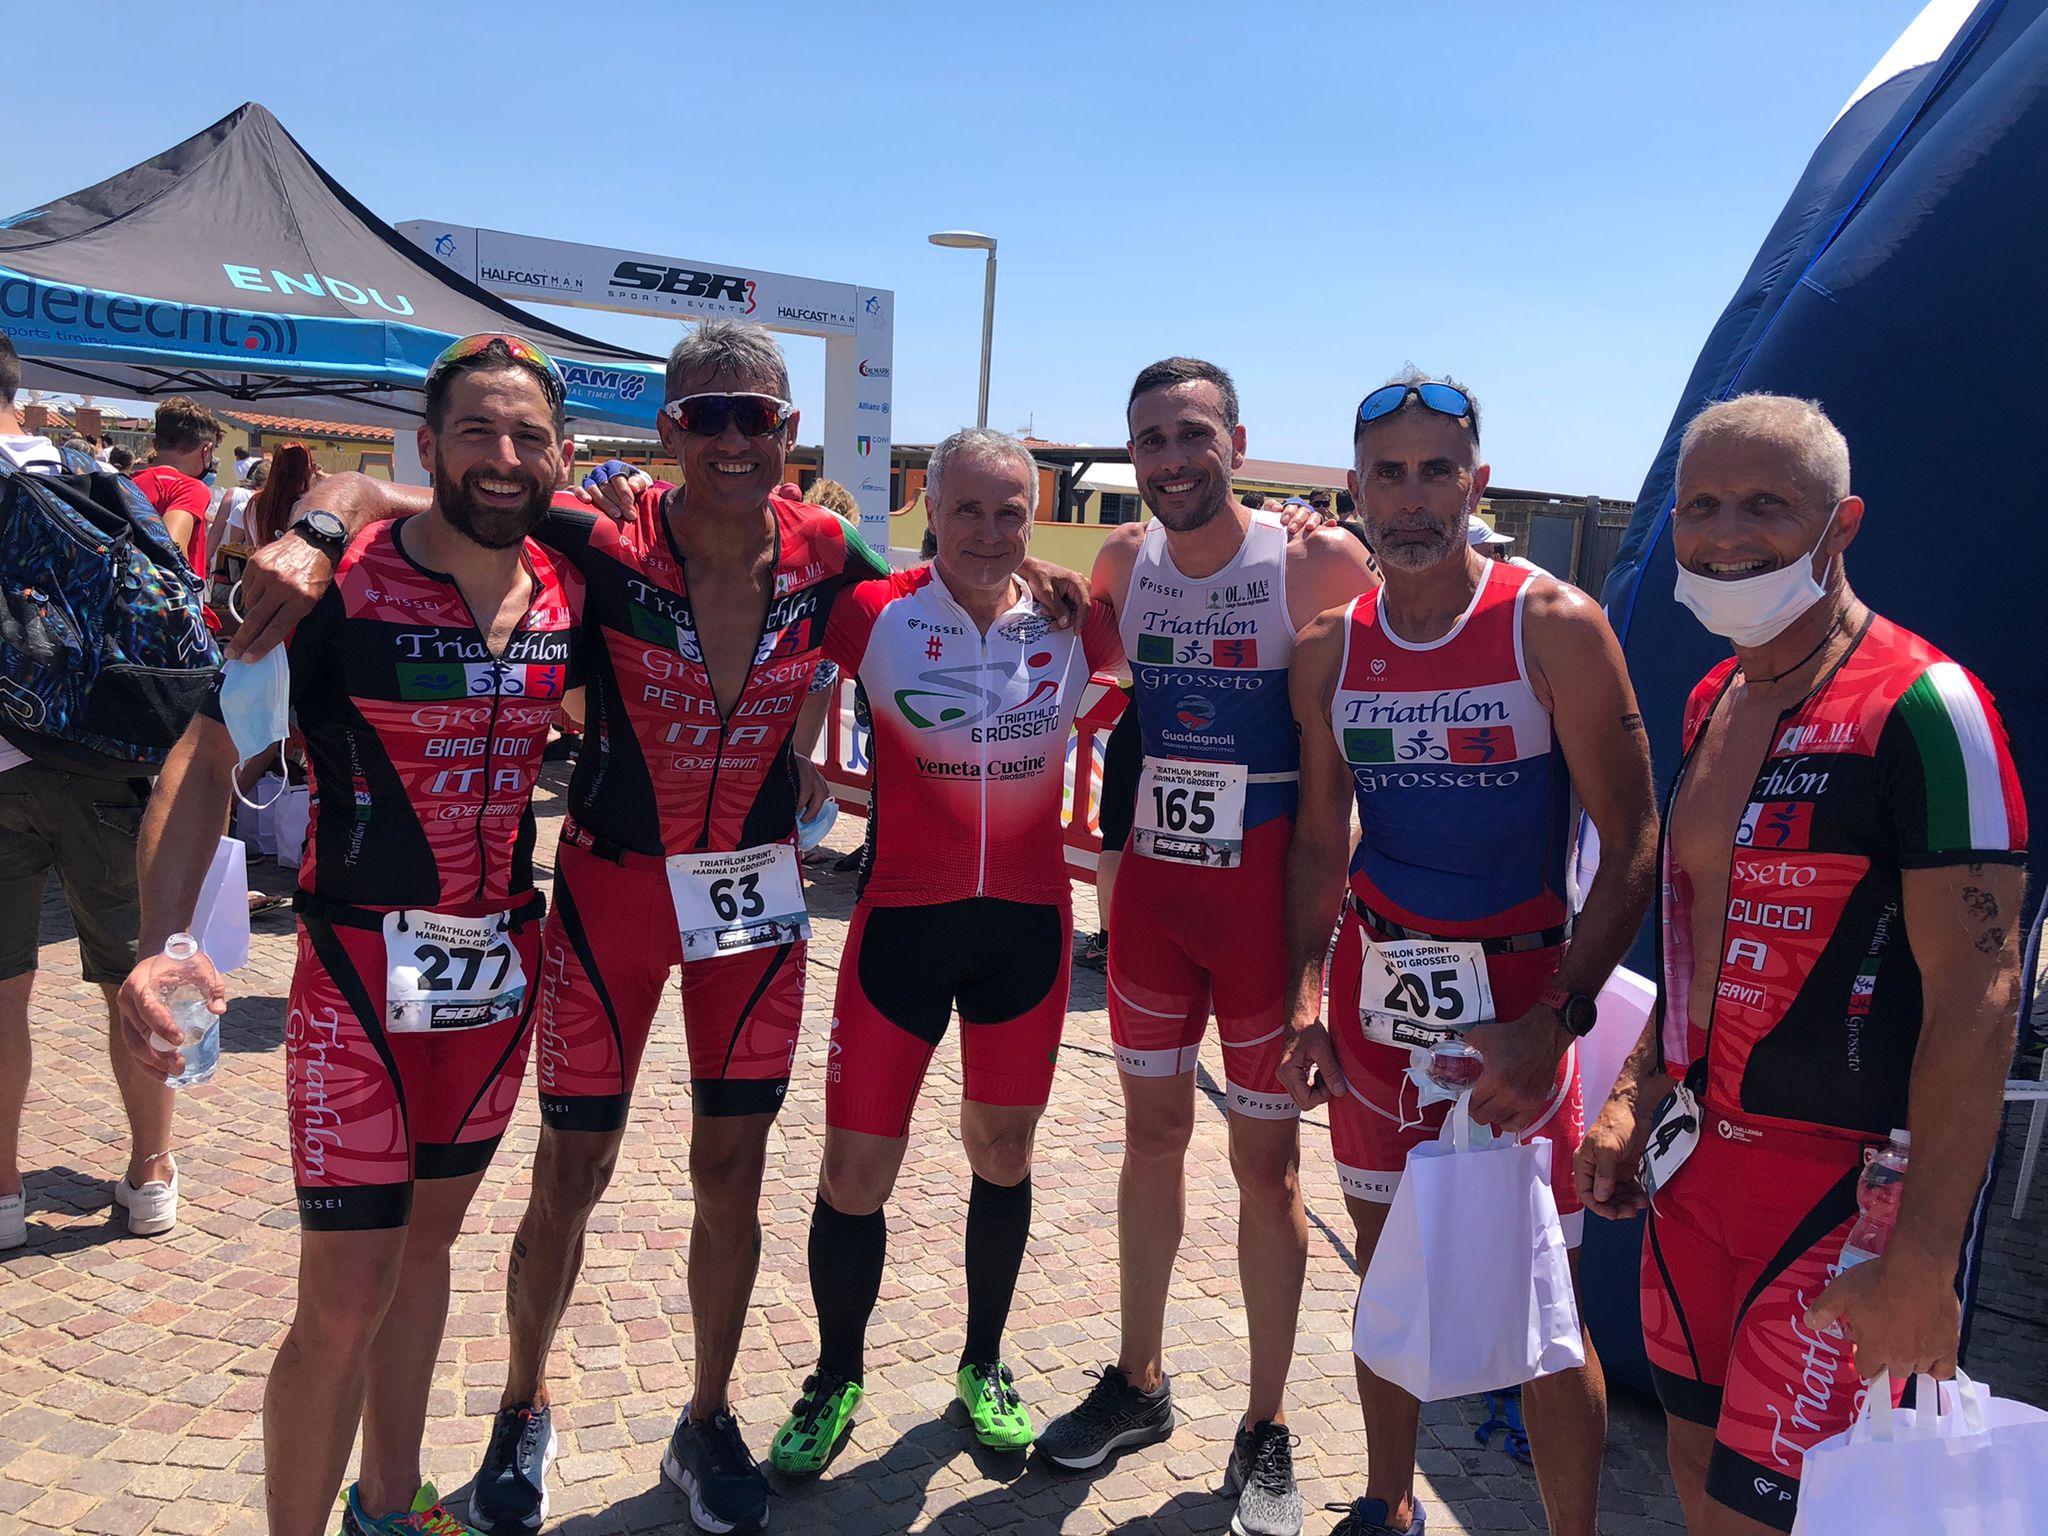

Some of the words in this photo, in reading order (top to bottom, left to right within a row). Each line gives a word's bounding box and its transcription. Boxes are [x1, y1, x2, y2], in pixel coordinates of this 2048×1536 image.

[223, 264, 415, 316] ENDU
[608, 290, 660, 303] SPORT
[688, 301, 745, 314] EVENTS
[587, 389, 617, 400] TIMER
[858, 402, 881, 411] Allianz
[1147, 581, 1184, 599] PISSEI
[384, 594, 439, 610] PISSEI
[921, 621, 964, 636] PISSEI
[1142, 608, 1258, 636] Triathlon
[1140, 667, 1263, 691] Grosseto
[996, 703, 1061, 726] TRIATHLON
[1344, 690, 1510, 724] Triathlon
[411, 704, 555, 734] Grosset
[971, 715, 1059, 744] GROSSETO
[664, 721, 769, 747] ITA
[1161, 729, 1236, 746] Guadagnoli
[424, 736, 533, 758] BIAGIONI
[915, 756, 981, 777] Veneta
[987, 752, 1046, 775] Cucine
[1193, 768, 1220, 779] SPRINT
[431, 767, 520, 794] ITA
[999, 771, 1036, 782] GROSSETO
[1176, 776, 1186, 784] DI
[1186, 778, 1227, 788] GROSSETO
[1353, 767, 1521, 793] Grosseto
[1152, 785, 1216, 835] 165
[692, 866, 728, 877] MARINA
[730, 866, 739, 875] DI
[740, 856, 776, 873] GROSSETO
[699, 856, 746, 869] TRIATHLON
[747, 849, 772, 863] SPRINT
[709, 872, 765, 922] 63
[1727, 897, 1813, 931] CUCCI
[415, 930, 456, 945] MARINA
[423, 921, 482, 938] TRIATHLON
[1397, 957, 1408, 969] DI
[1409, 953, 1461, 969] GROSSETO
[1415, 945, 1451, 957] SPRINT
[413, 943, 511, 992] 277
[1383, 964, 1465, 1021] 205
[1717, 981, 1763, 1006] ERVIT
[541, 945, 571, 1088] Triathlon
[305, 1006, 345, 1180] Triathlon
[1250, 1100, 1296, 1111] PISSEI
[1342, 1174, 1390, 1193] PISSEI
